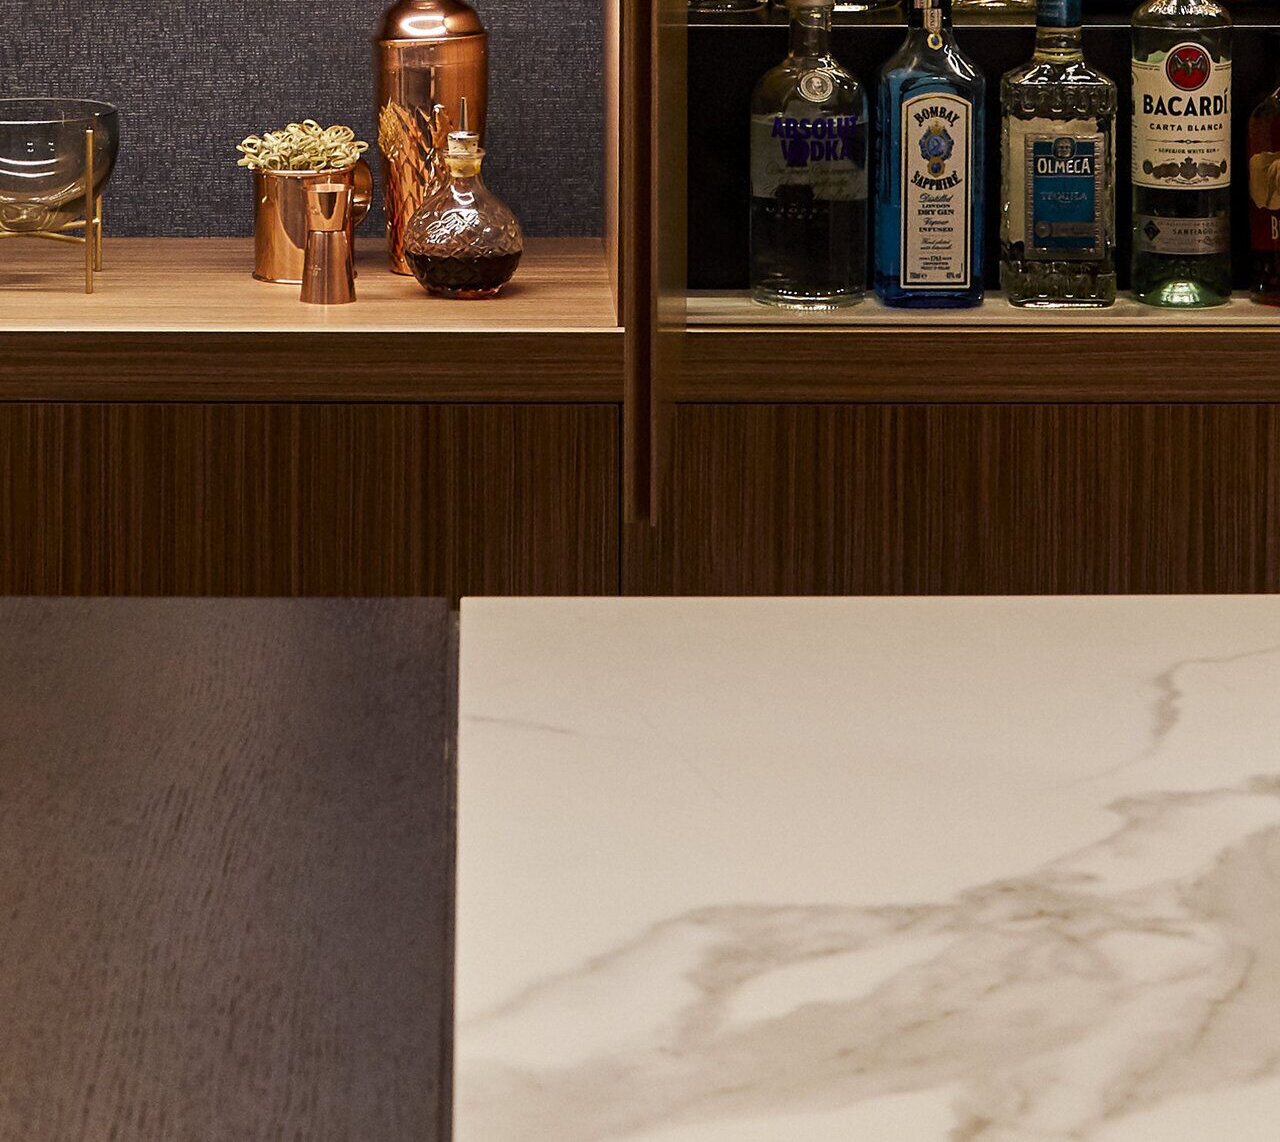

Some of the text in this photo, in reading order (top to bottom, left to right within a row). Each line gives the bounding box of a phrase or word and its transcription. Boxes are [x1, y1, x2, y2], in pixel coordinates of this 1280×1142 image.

[1143, 88, 1228, 117] BACARDÍ
[913, 105, 961, 127] BOMBAY
[1149, 122, 1224, 132] CARTA BLANCA
[771, 116, 858, 139] ABSOLUT
[780, 139, 850, 162] VODKA
[1036, 157, 1092, 174] OLMECA
[910, 170, 963, 191] SAPPHIRE
